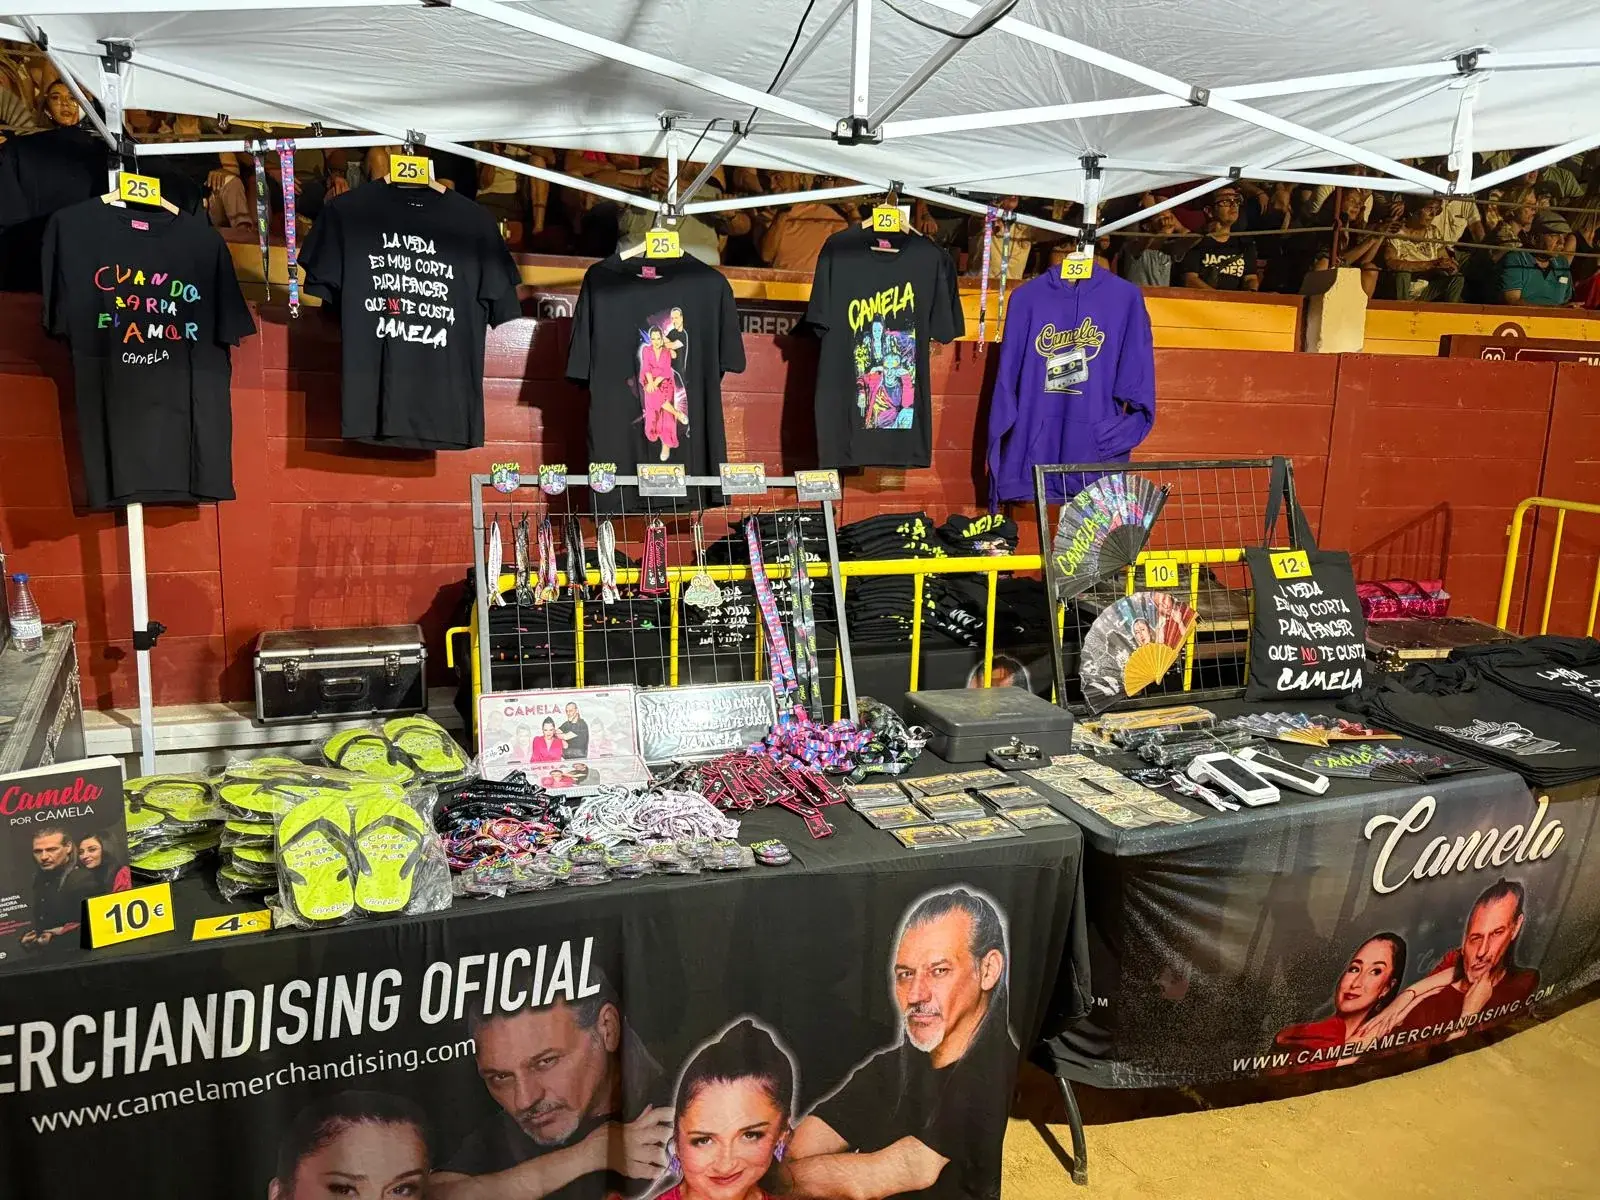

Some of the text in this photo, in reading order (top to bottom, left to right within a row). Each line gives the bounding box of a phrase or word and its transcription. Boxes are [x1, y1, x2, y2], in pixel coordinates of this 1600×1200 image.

[382, 232, 437, 256] LA VIDA
[368, 253, 454, 280] ES MUY CORTA
[372, 273, 449, 302] PARA FINGIR
[364, 297, 387, 313] QUE
[400, 297, 417, 315] TE
[418, 302, 456, 327] GUSTA
[848, 281, 915, 339] CAMELA
[122, 321, 199, 344] AMOR
[376, 316, 448, 350] CAMELA
[1037, 317, 1102, 353] Camela
[121, 348, 170, 365] CAMELA
[1055, 517, 1100, 577] CAMELA
[1286, 581, 1324, 599] VIDA
[1309, 599, 1351, 617] CORTA
[1306, 619, 1355, 639] FINGIR
[1268, 644, 1298, 662] QUE
[1300, 645, 1318, 666] NO
[1318, 645, 1335, 661] TE
[1276, 667, 1363, 693] CAMELA
[503, 703, 562, 718] CAMELA
[0, 777, 104, 816] Camela
[10, 805, 95, 826] POR CAMELA
[1364, 795, 1566, 895] Camela
[419, 936, 601, 1026] OFICIAL
[31, 1036, 477, 1135] www.camelamerchandising.com
